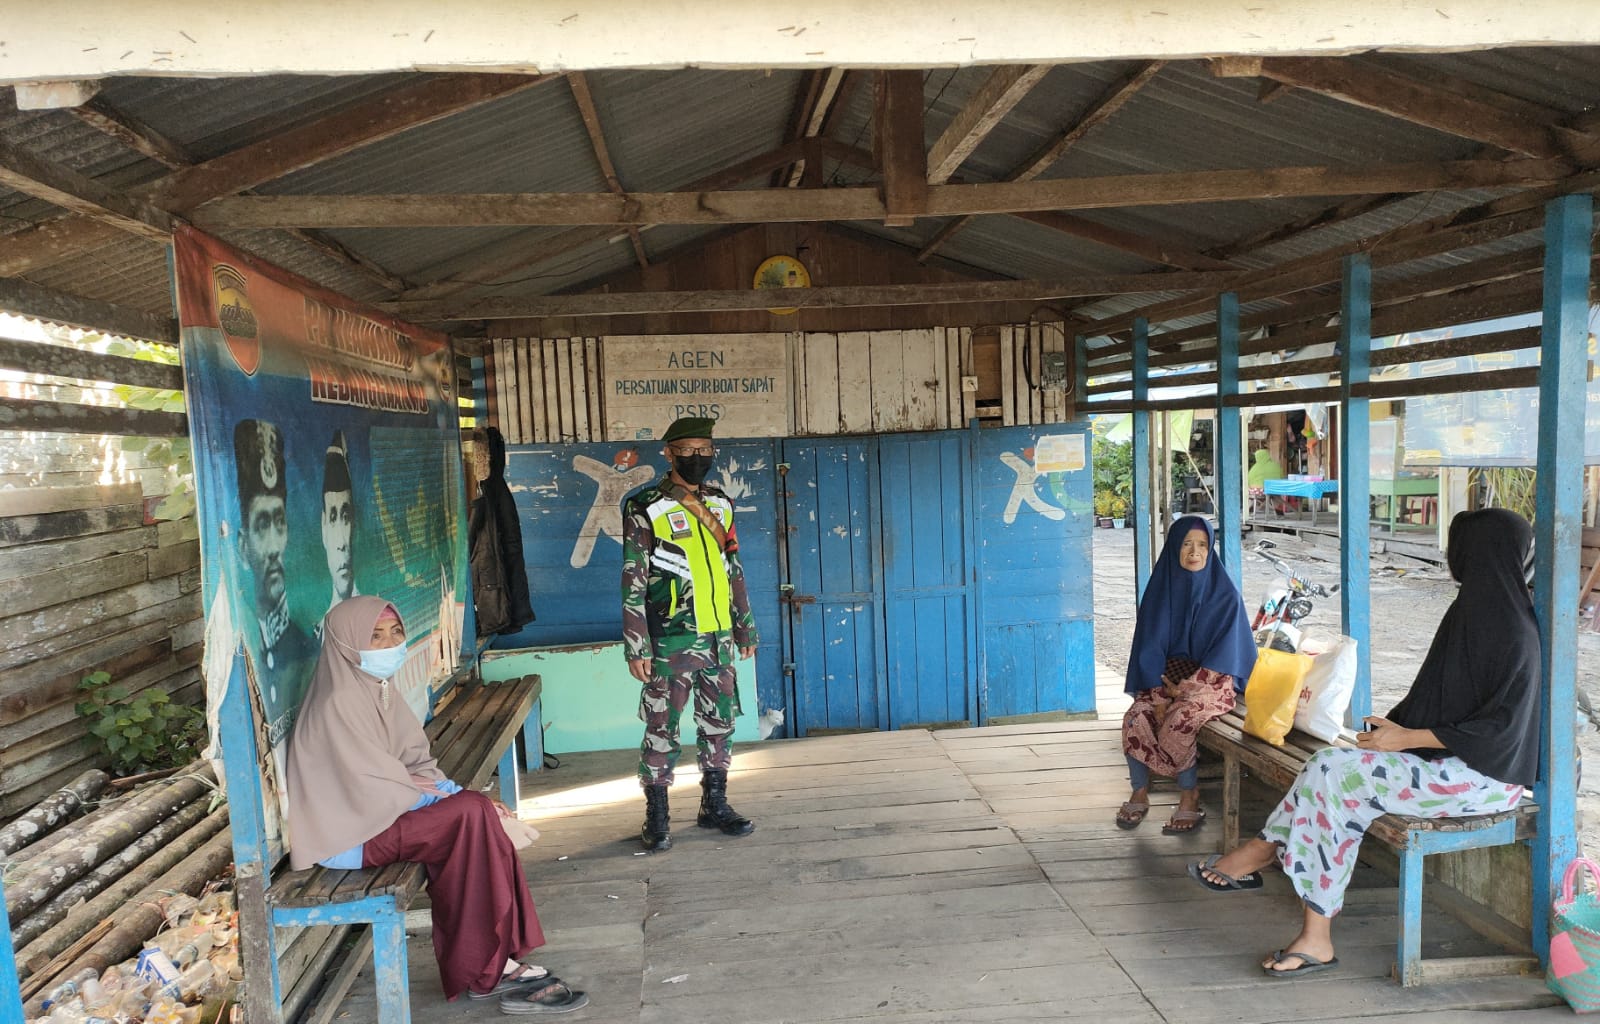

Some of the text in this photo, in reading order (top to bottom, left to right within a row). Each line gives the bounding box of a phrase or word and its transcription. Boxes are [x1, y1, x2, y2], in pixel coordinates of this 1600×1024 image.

[668, 351, 724, 368] AGEN
[615, 379, 678, 395] PERSATUAN
[679, 377, 711, 394] SUPIR
[713, 377, 739, 393] BOAT
